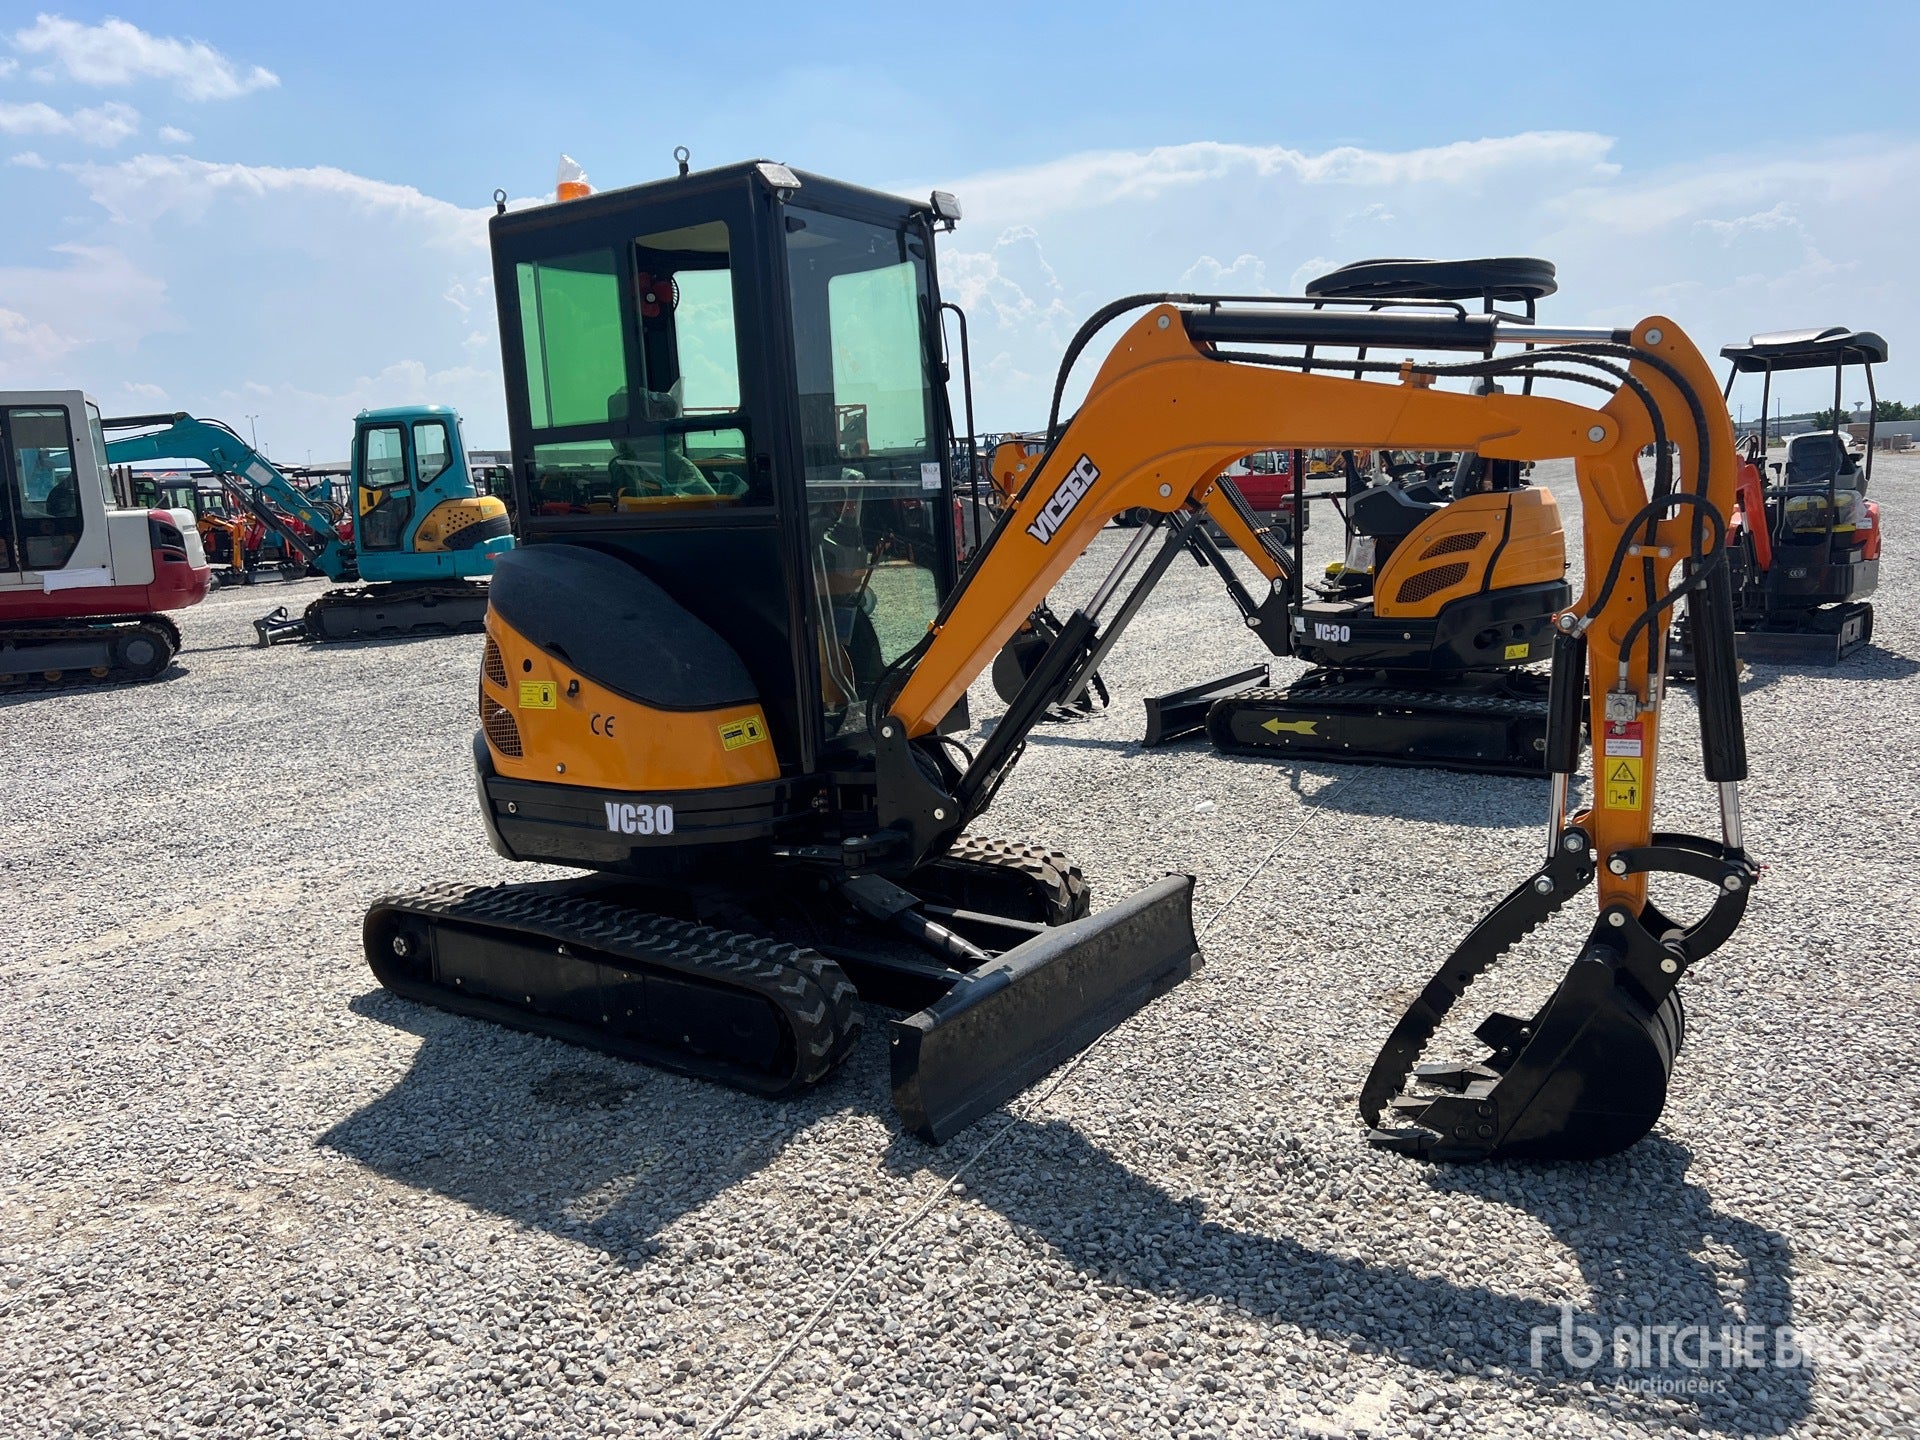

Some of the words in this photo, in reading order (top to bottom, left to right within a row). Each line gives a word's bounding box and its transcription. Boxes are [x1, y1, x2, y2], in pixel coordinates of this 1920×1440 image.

[1027, 454, 1100, 544] VICSEC
[1314, 623, 1350, 642] VC30
[591, 714, 615, 737] CE
[605, 802, 674, 835] VC30
